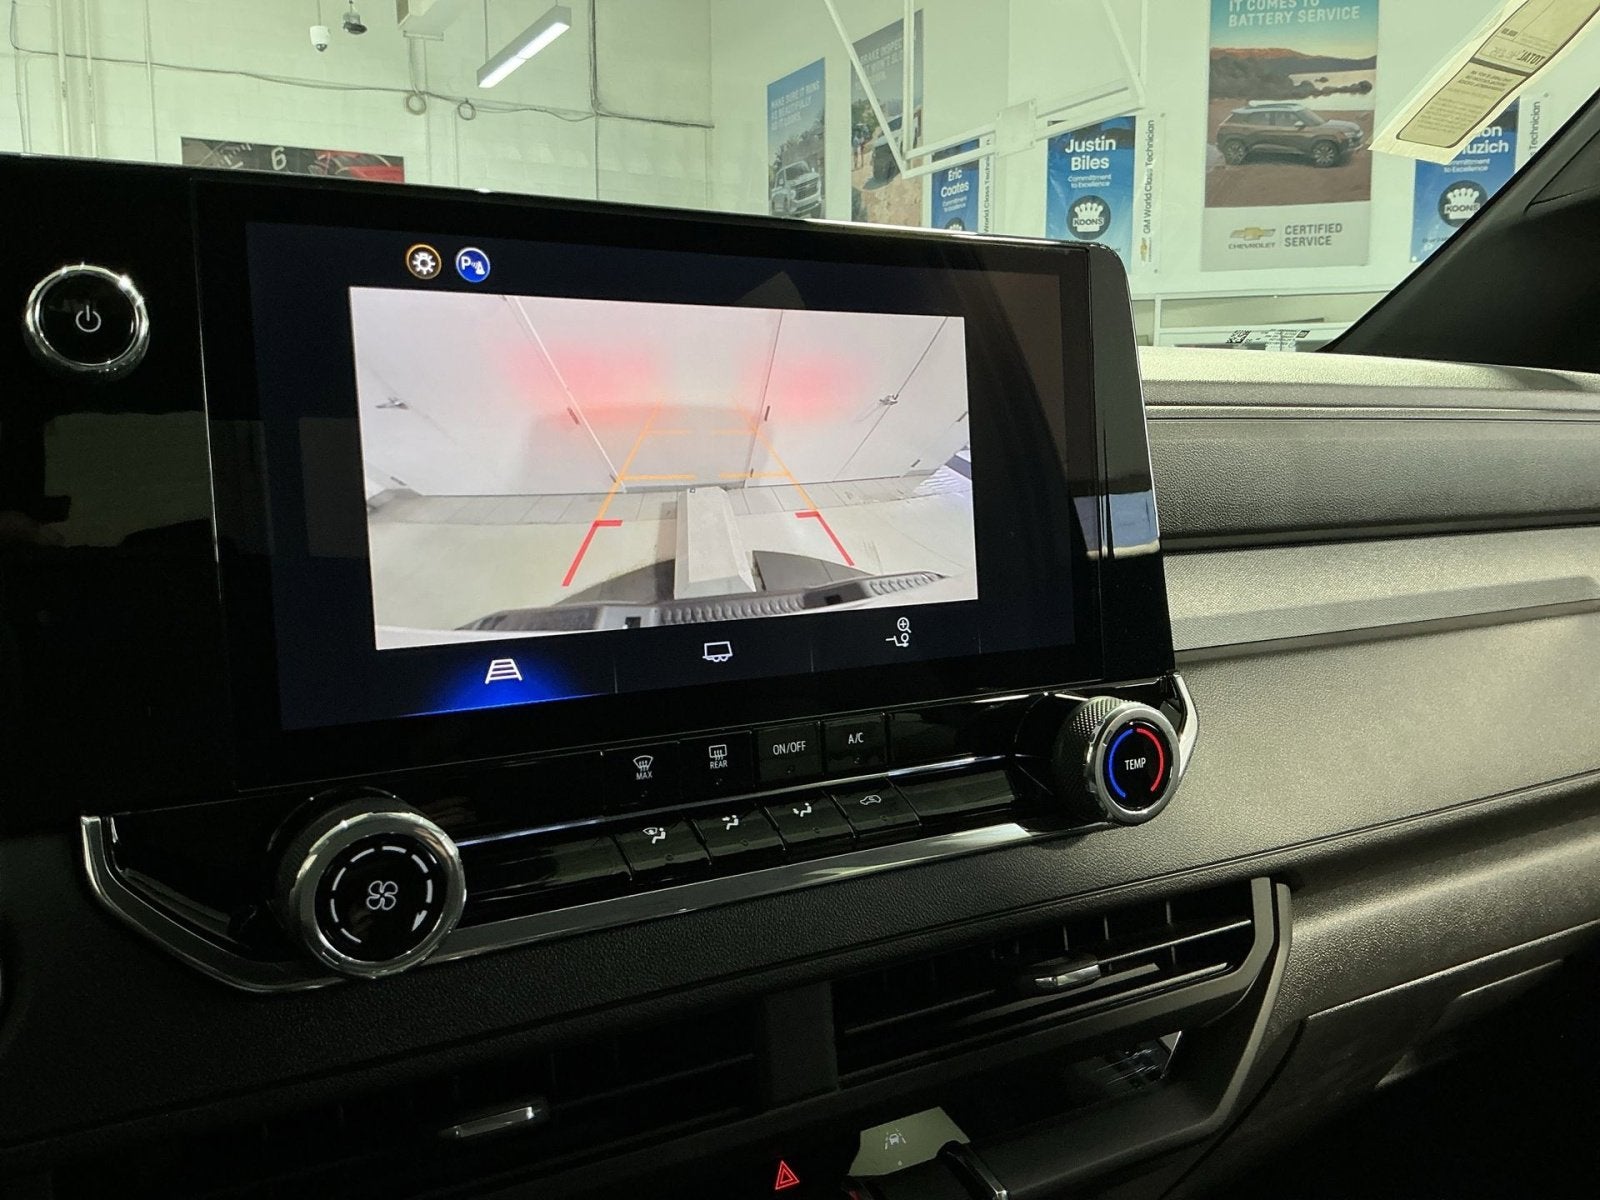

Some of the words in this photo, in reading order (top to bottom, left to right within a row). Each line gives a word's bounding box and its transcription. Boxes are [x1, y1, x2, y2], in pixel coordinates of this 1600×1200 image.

[1229, 0, 1241, 12] IT
[1228, 10, 1294, 28] BATTERY
[1298, 5, 1360, 23] SERVICE
[1529, 101, 1541, 150] Technician
[1064, 136, 1117, 153] Justin
[1145, 119, 1155, 167] Technician
[271, 146, 287, 171] 6
[1071, 155, 1111, 171] Biles
[947, 167, 963, 181] Eric
[1144, 168, 1154, 191] Class
[941, 181, 970, 198] Coates
[1143, 192, 1152, 220] World
[1446, 203, 1479, 213] KOONS
[1073, 217, 1104, 227] KOONS
[1143, 221, 1151, 234] GM
[1284, 223, 1343, 235] CERTIFIED
[1228, 242, 1276, 250] CHEVROLET
[1284, 235, 1332, 247] SERVICE
[848, 732, 864, 744] A/C
[772, 741, 806, 755] ON/OFF
[710, 759, 728, 769] REAR
[1124, 757, 1147, 770] TEMP
[636, 770, 653, 780] MAX
